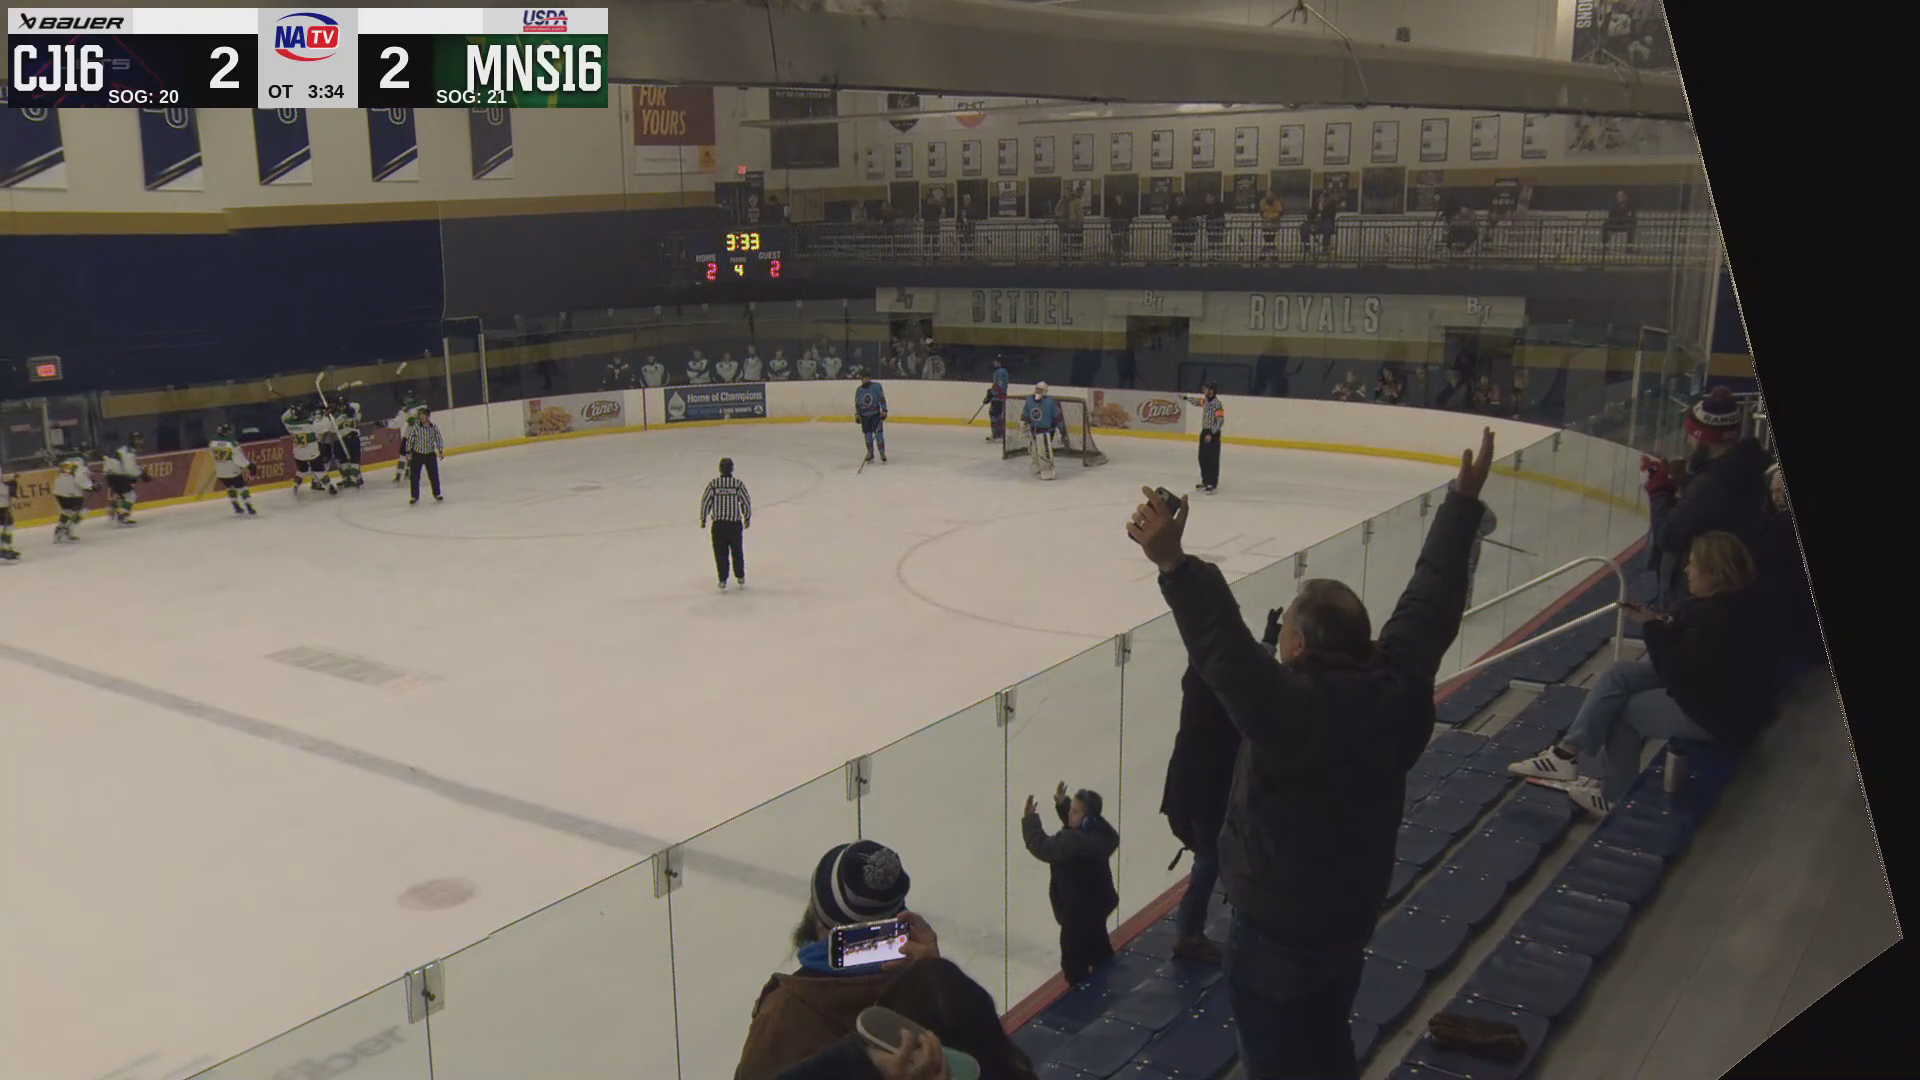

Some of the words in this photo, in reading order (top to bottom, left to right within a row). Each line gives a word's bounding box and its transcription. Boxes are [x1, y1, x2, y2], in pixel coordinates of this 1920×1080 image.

[639, 86, 667, 107] FOR
[641, 109, 687, 136] YOURS
[726, 232, 760, 252] 3:33
[695, 254, 717, 263] HOME
[758, 250, 781, 260] GUEST
[706, 262, 718, 281] 2
[734, 264, 744, 277] 4
[770, 260, 782, 278] 2
[972, 289, 1074, 326] BETHEL
[1247, 293, 1383, 334] ROYALS
[687, 393, 710, 403] Home
[711, 392, 719, 402] of
[720, 390, 763, 403] Champions
[16, 482, 51, 498] LTH
